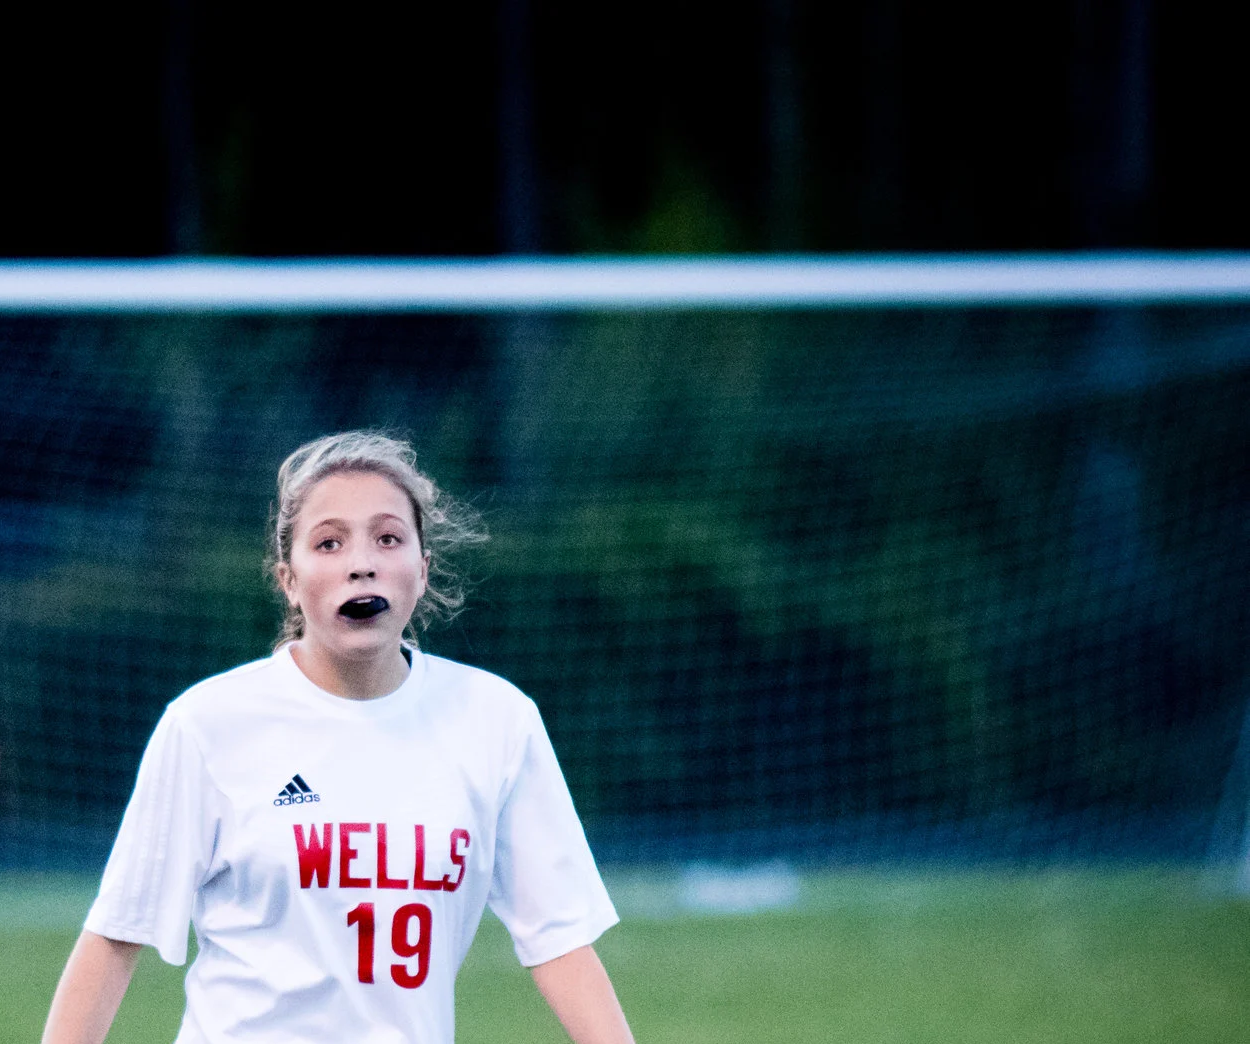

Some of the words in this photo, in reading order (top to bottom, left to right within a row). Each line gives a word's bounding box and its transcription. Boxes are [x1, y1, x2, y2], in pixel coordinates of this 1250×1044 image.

[273, 792, 320, 807] adidas
[293, 822, 471, 892] WELLS
[347, 902, 433, 989] 19
